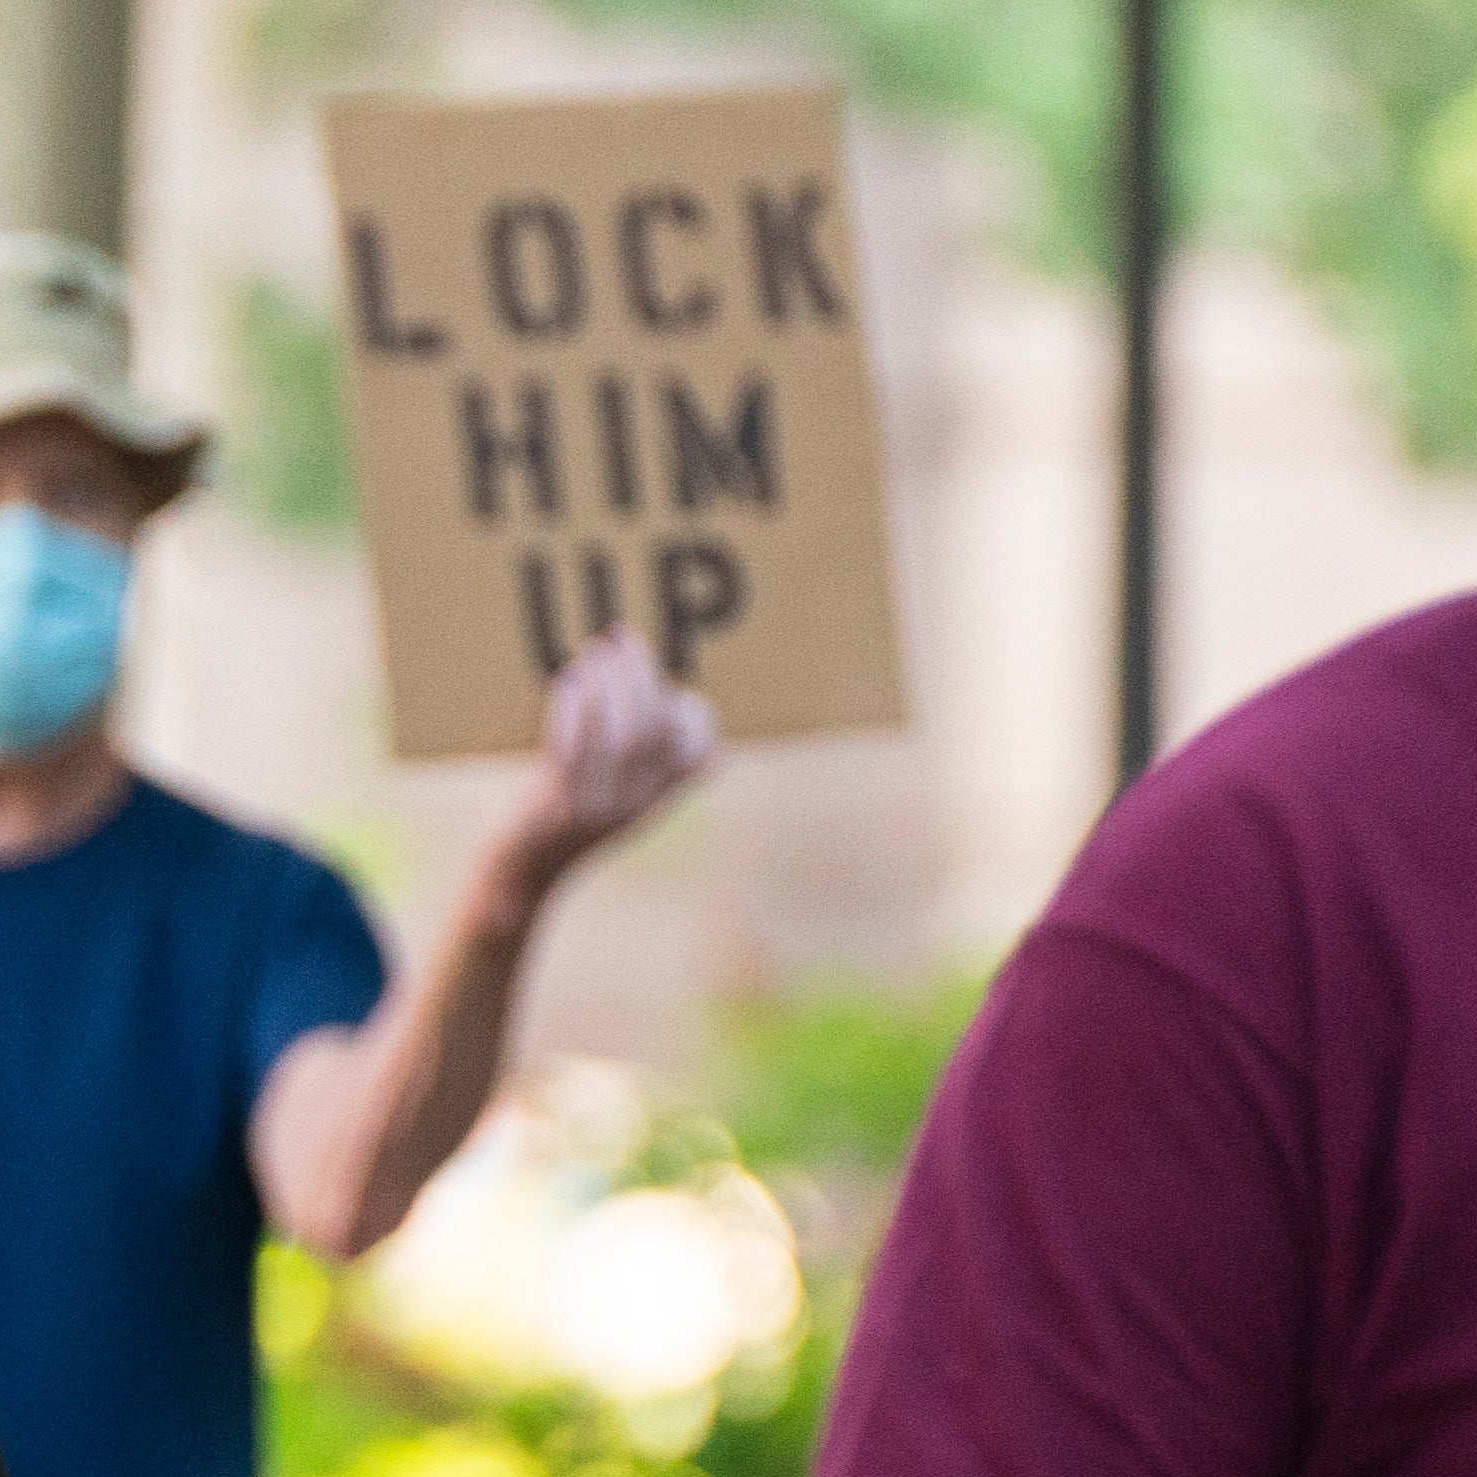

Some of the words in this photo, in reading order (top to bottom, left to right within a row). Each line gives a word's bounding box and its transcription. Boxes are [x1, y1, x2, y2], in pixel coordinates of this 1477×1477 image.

[348, 180, 845, 355] LOCK
[457, 372, 783, 521] HIM
[518, 536, 752, 680] UP
